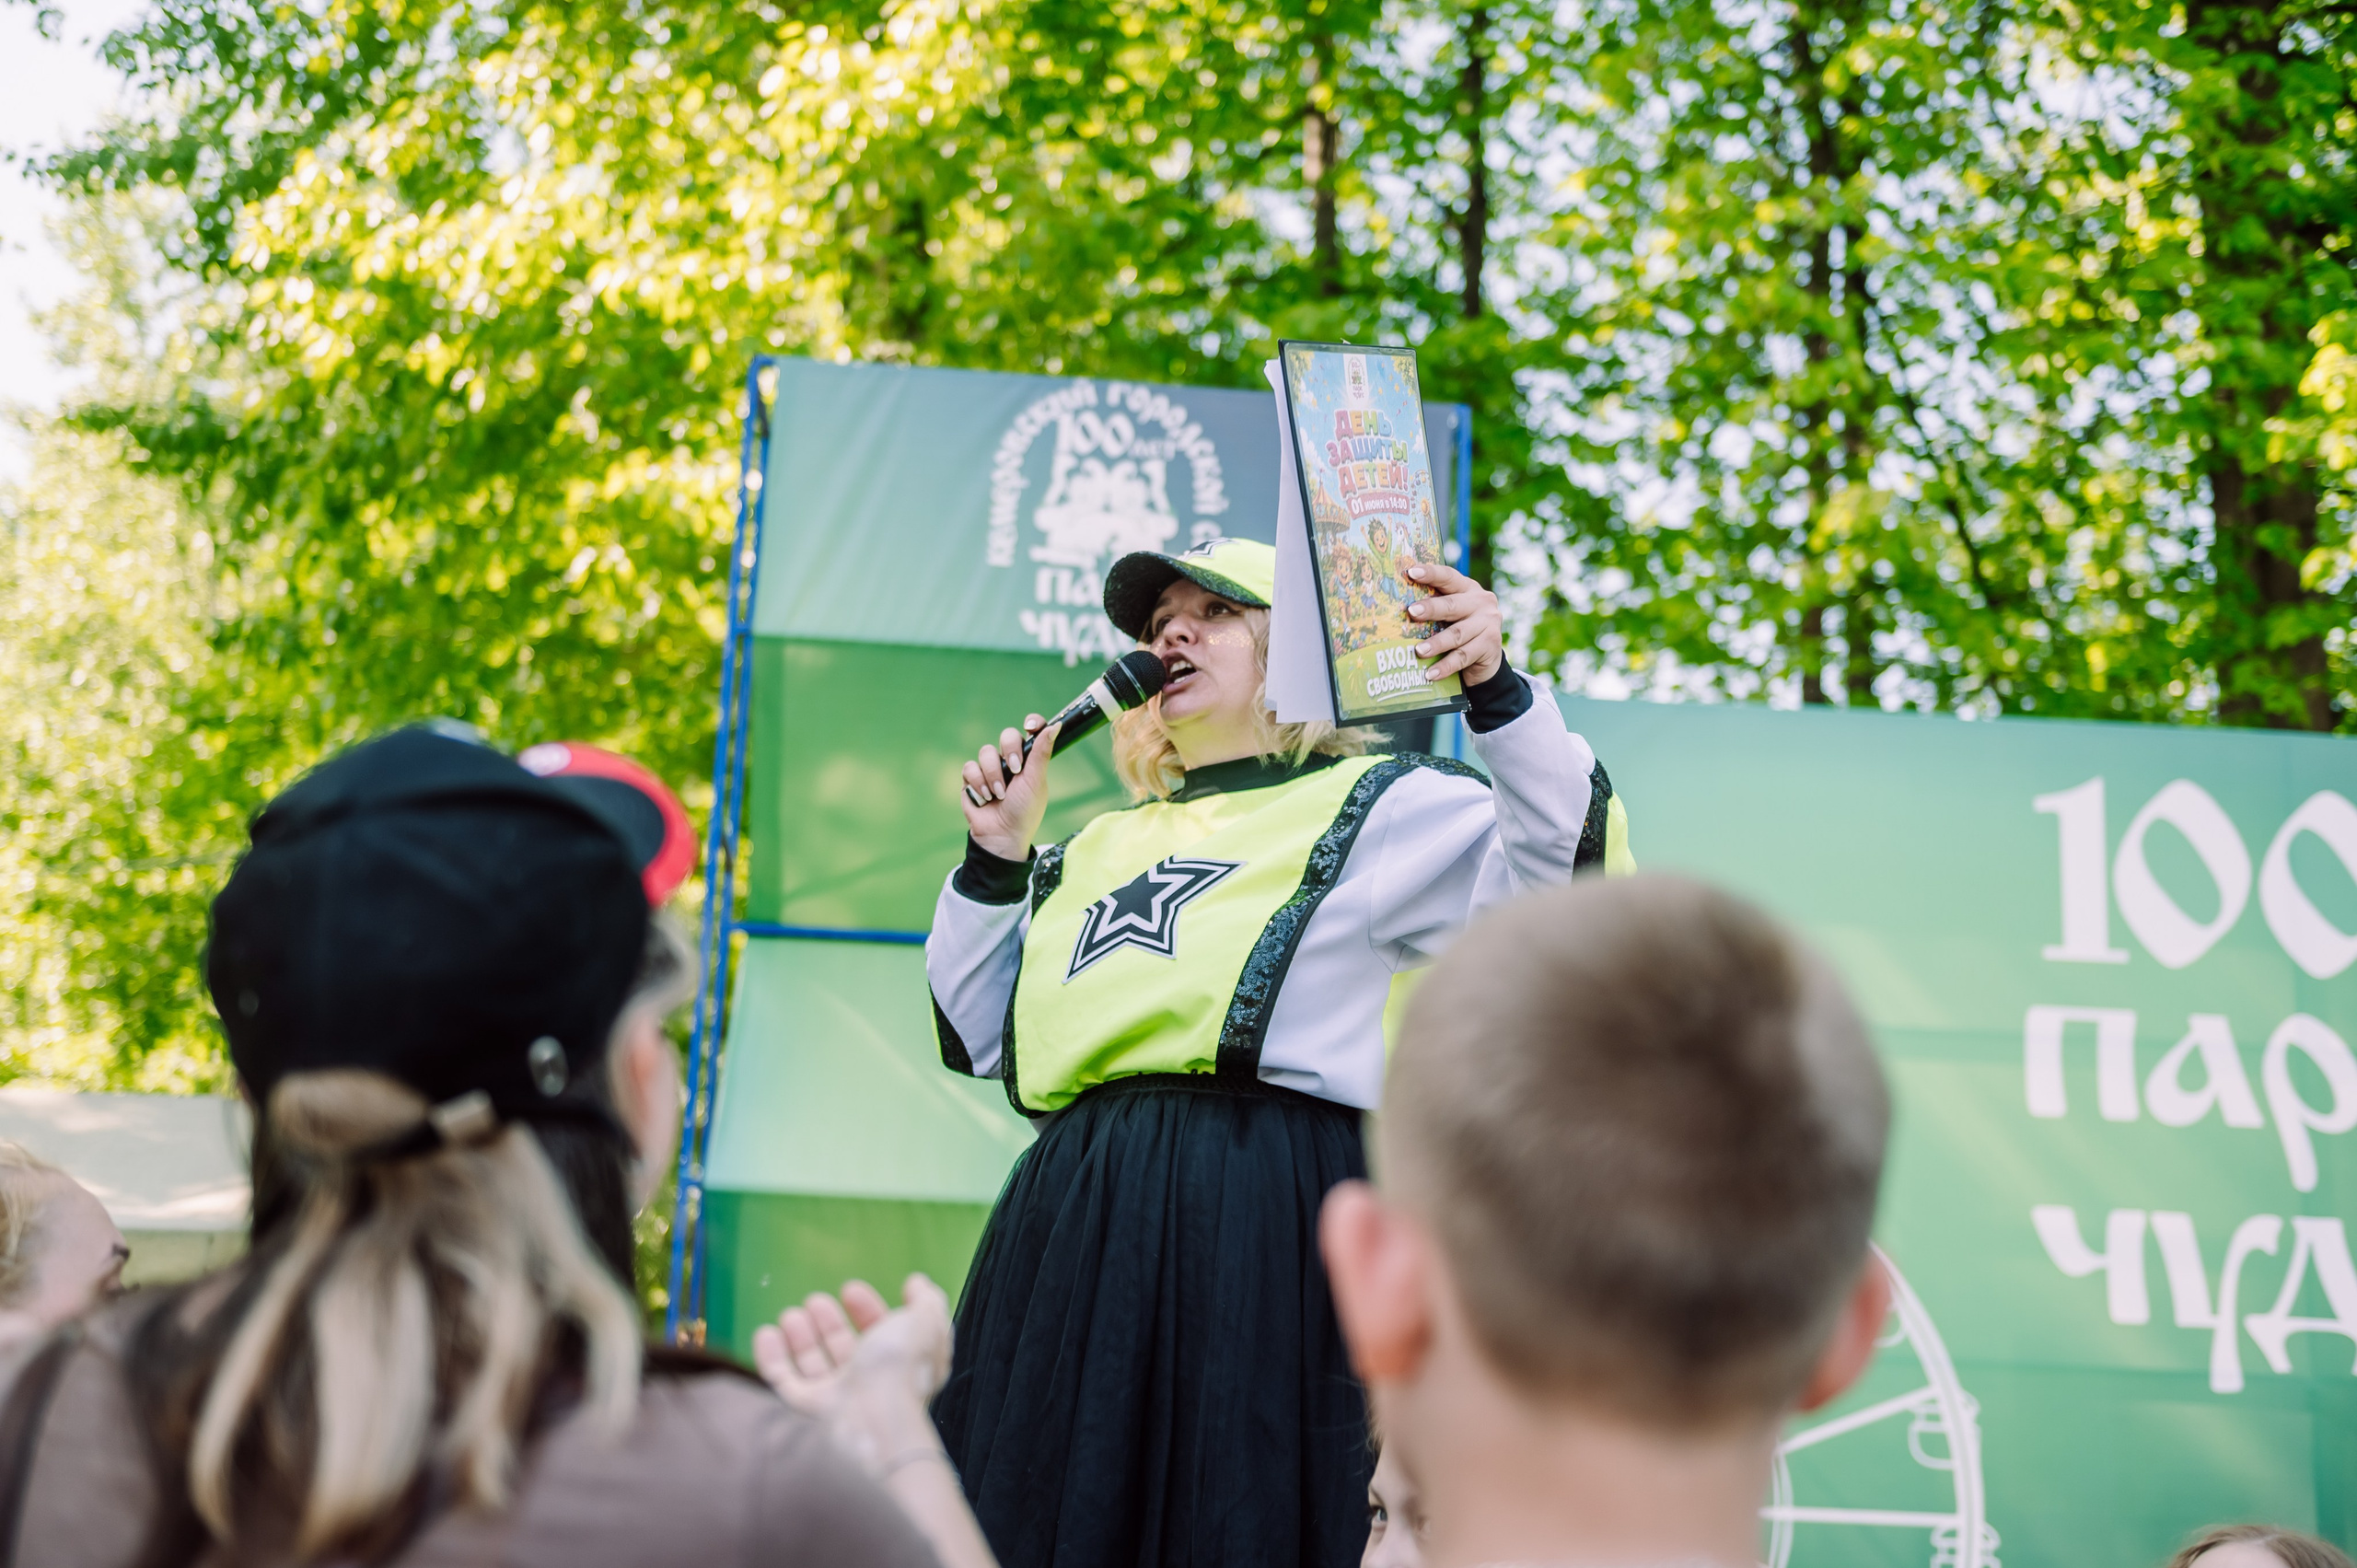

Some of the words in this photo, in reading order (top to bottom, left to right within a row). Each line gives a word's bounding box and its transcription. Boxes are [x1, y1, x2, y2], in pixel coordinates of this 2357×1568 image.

[1055, 410, 1135, 459] 100
[1334, 408, 1393, 442] ДЕНЬ
[1325, 436, 1409, 467] ЗАЩИТЫ
[1338, 460, 1409, 499] ДЕТЕЙ!
[1351, 497, 1364, 515] 01
[1389, 496, 1408, 510] 14:00
[1376, 645, 1419, 674] ВХОД
[1366, 664, 1434, 698] СВОБОДНЫЙ
[2032, 775, 2357, 980] 100
